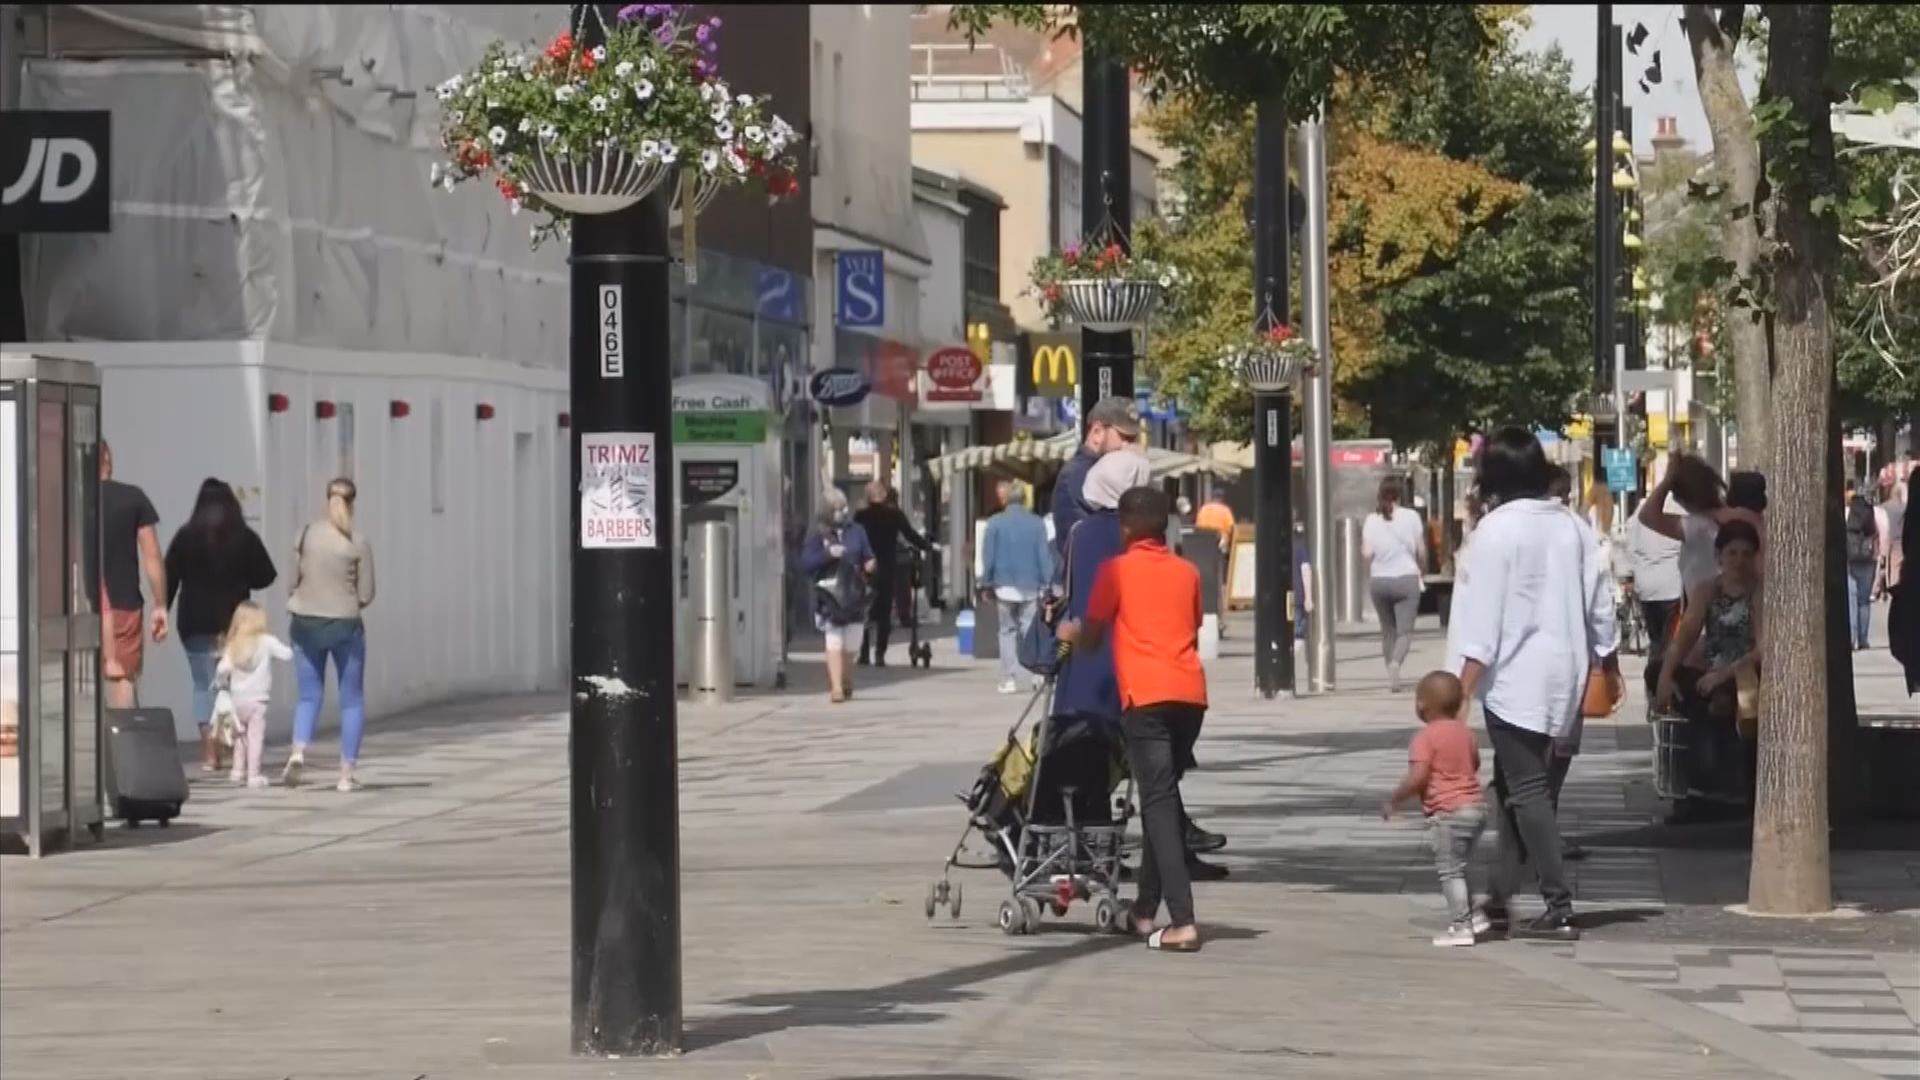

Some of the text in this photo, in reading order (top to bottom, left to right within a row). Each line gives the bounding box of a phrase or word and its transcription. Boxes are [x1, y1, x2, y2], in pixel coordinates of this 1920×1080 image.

[2, 138, 97, 204] JD
[845, 257, 876, 271] WH
[845, 271, 878, 321] S
[604, 290, 619, 373] 046E
[939, 355, 970, 367] POST
[933, 367, 977, 379] OFFICE
[673, 395, 750, 409] Free Cash
[587, 444, 649, 464] TRIMZ
[587, 518, 652, 538] BARBERS
